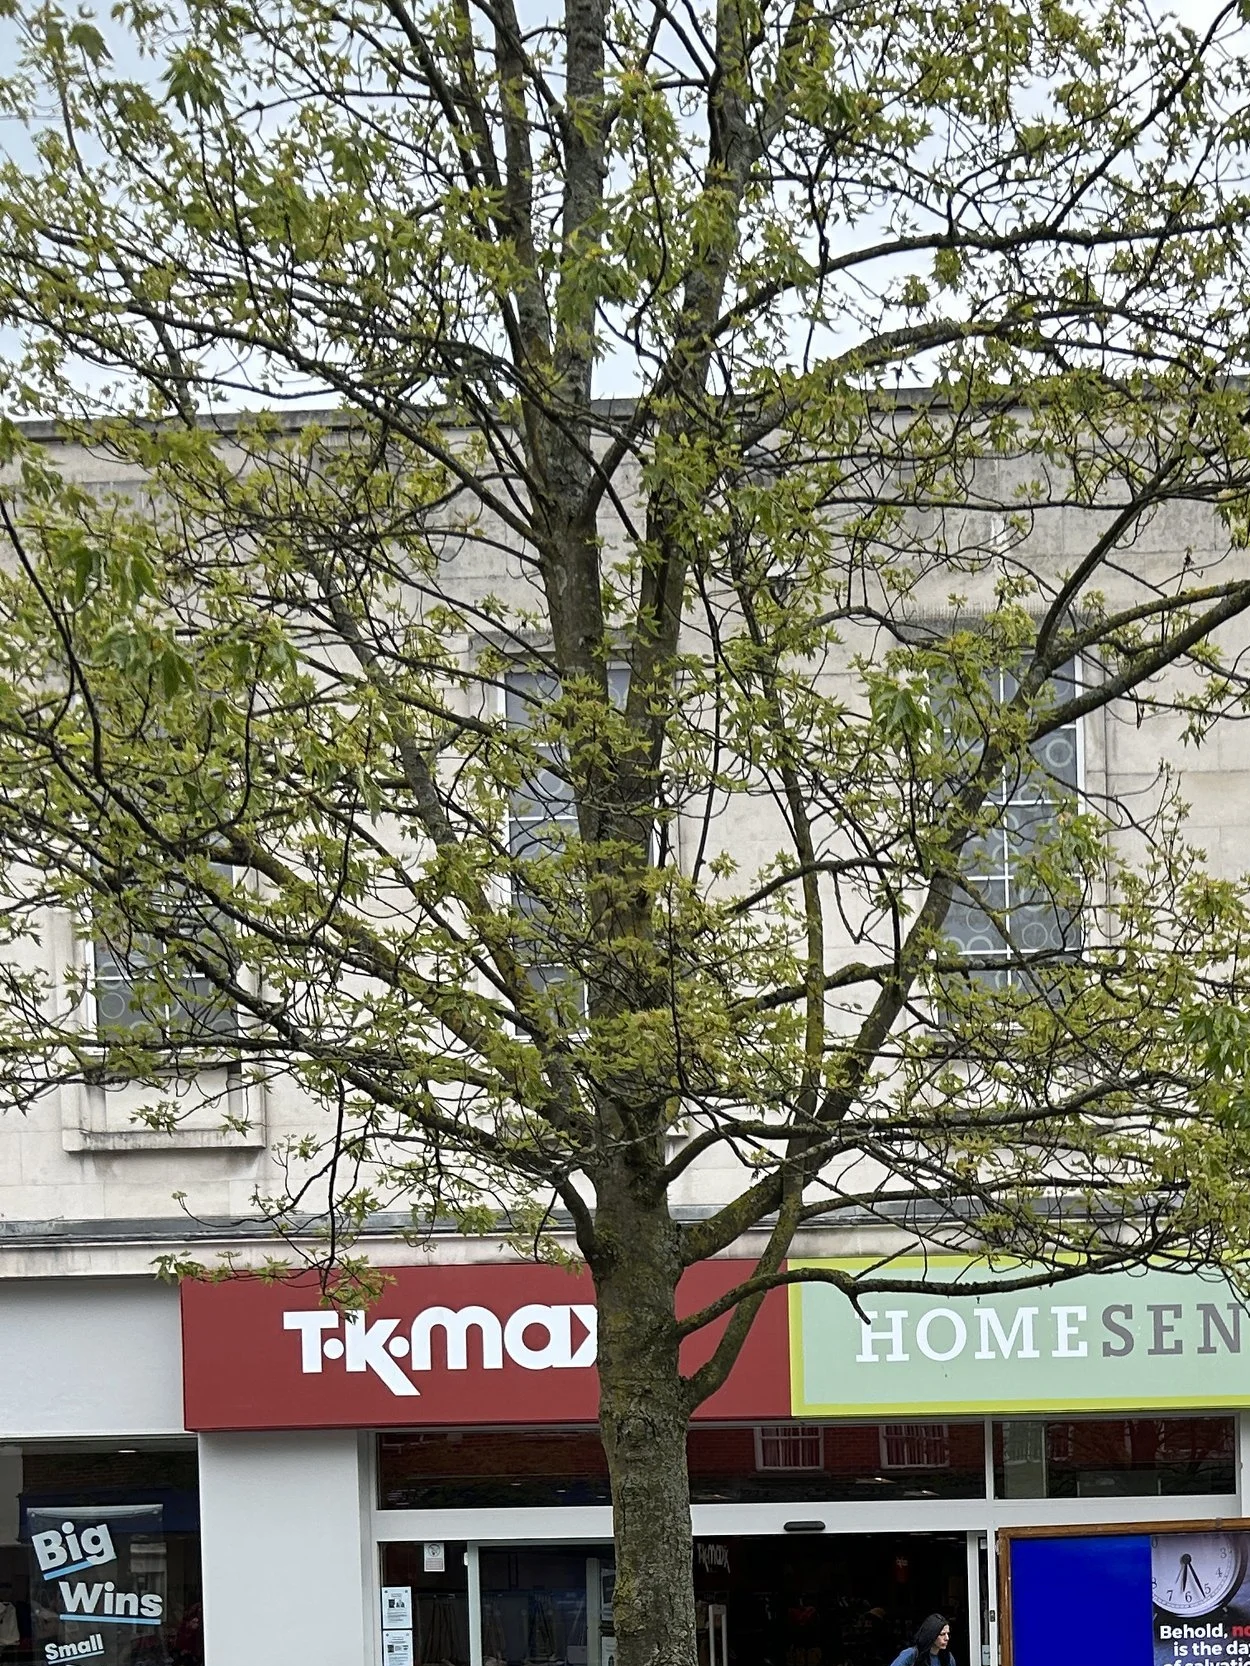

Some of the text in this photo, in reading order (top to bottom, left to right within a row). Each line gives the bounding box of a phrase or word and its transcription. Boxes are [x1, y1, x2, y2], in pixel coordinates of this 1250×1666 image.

[32, 1521, 117, 1571] Big
[58, 1581, 163, 1617] Wins
[1160, 1623, 1228, 1640] Behold,
[44, 1633, 104, 1661] Small
[1173, 1641, 1188, 1656] is
[1191, 1642, 1222, 1656] the
